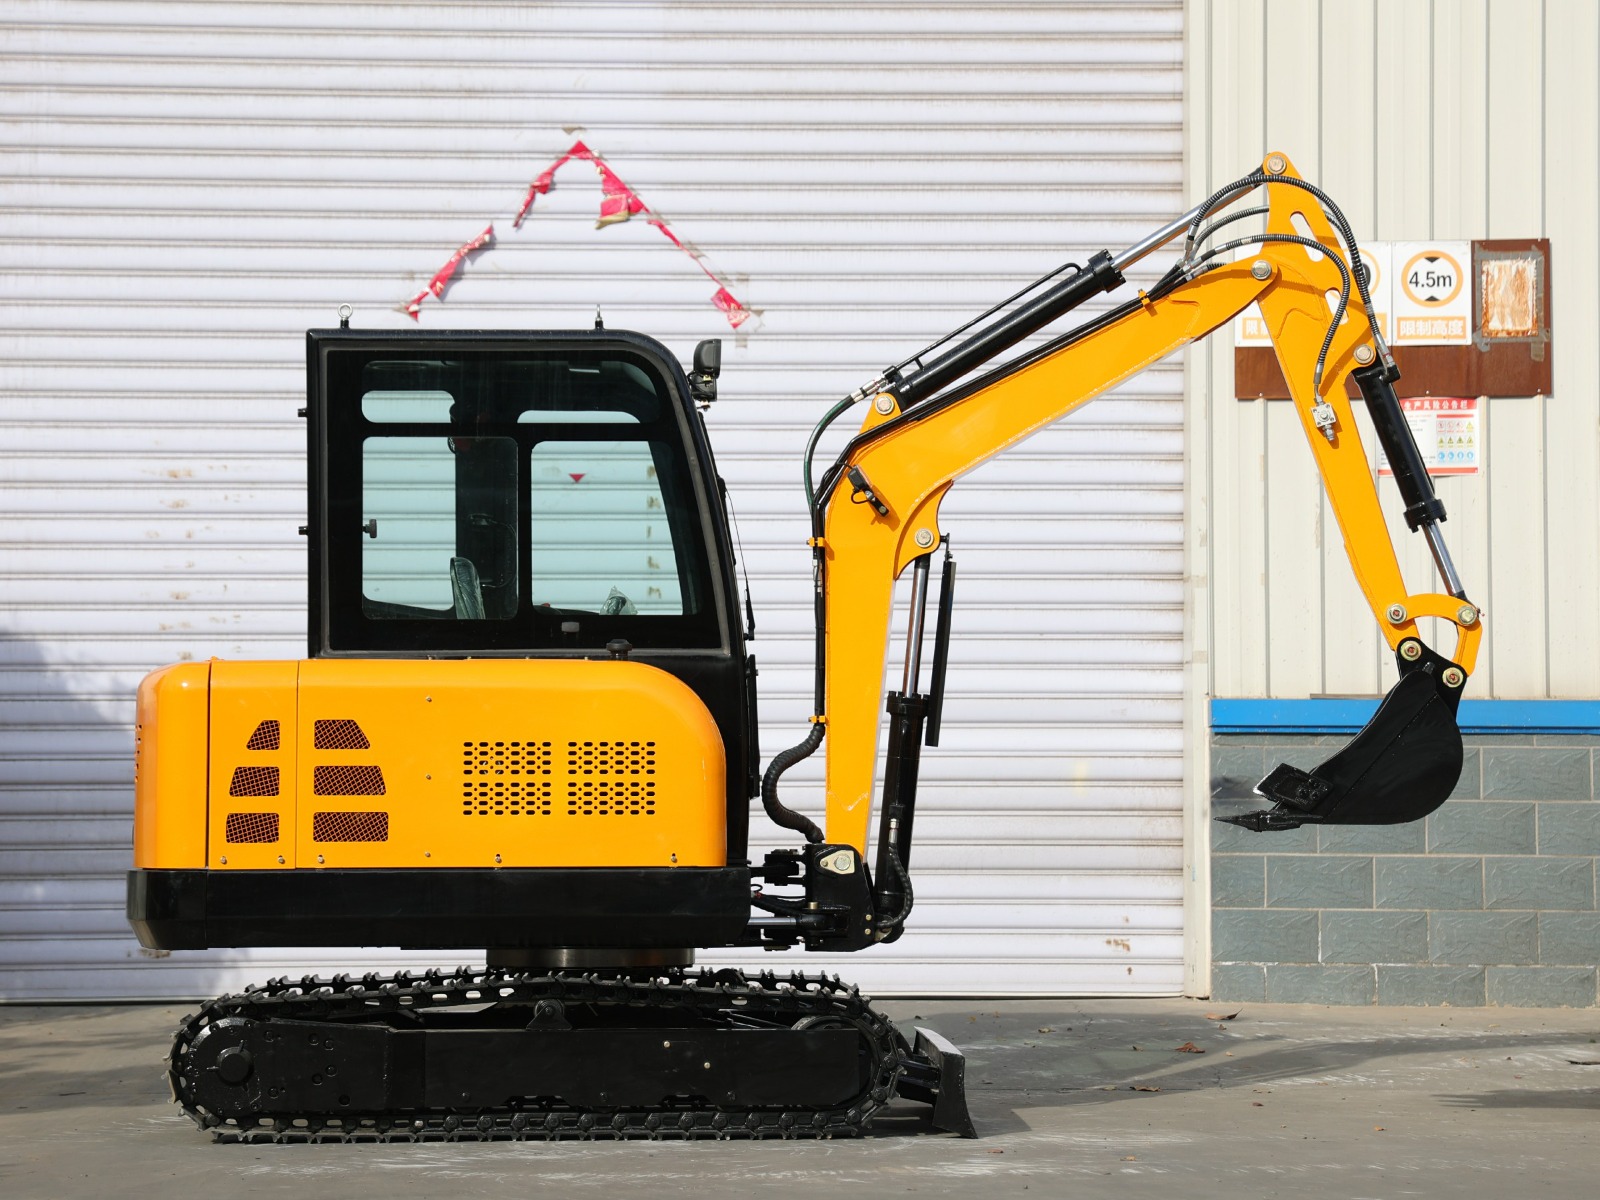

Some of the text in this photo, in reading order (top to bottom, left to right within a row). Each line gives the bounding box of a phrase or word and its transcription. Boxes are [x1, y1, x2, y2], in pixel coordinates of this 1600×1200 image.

[1409, 271, 1452, 288] 4.5m
[1400, 319, 1464, 336] 限制高度
